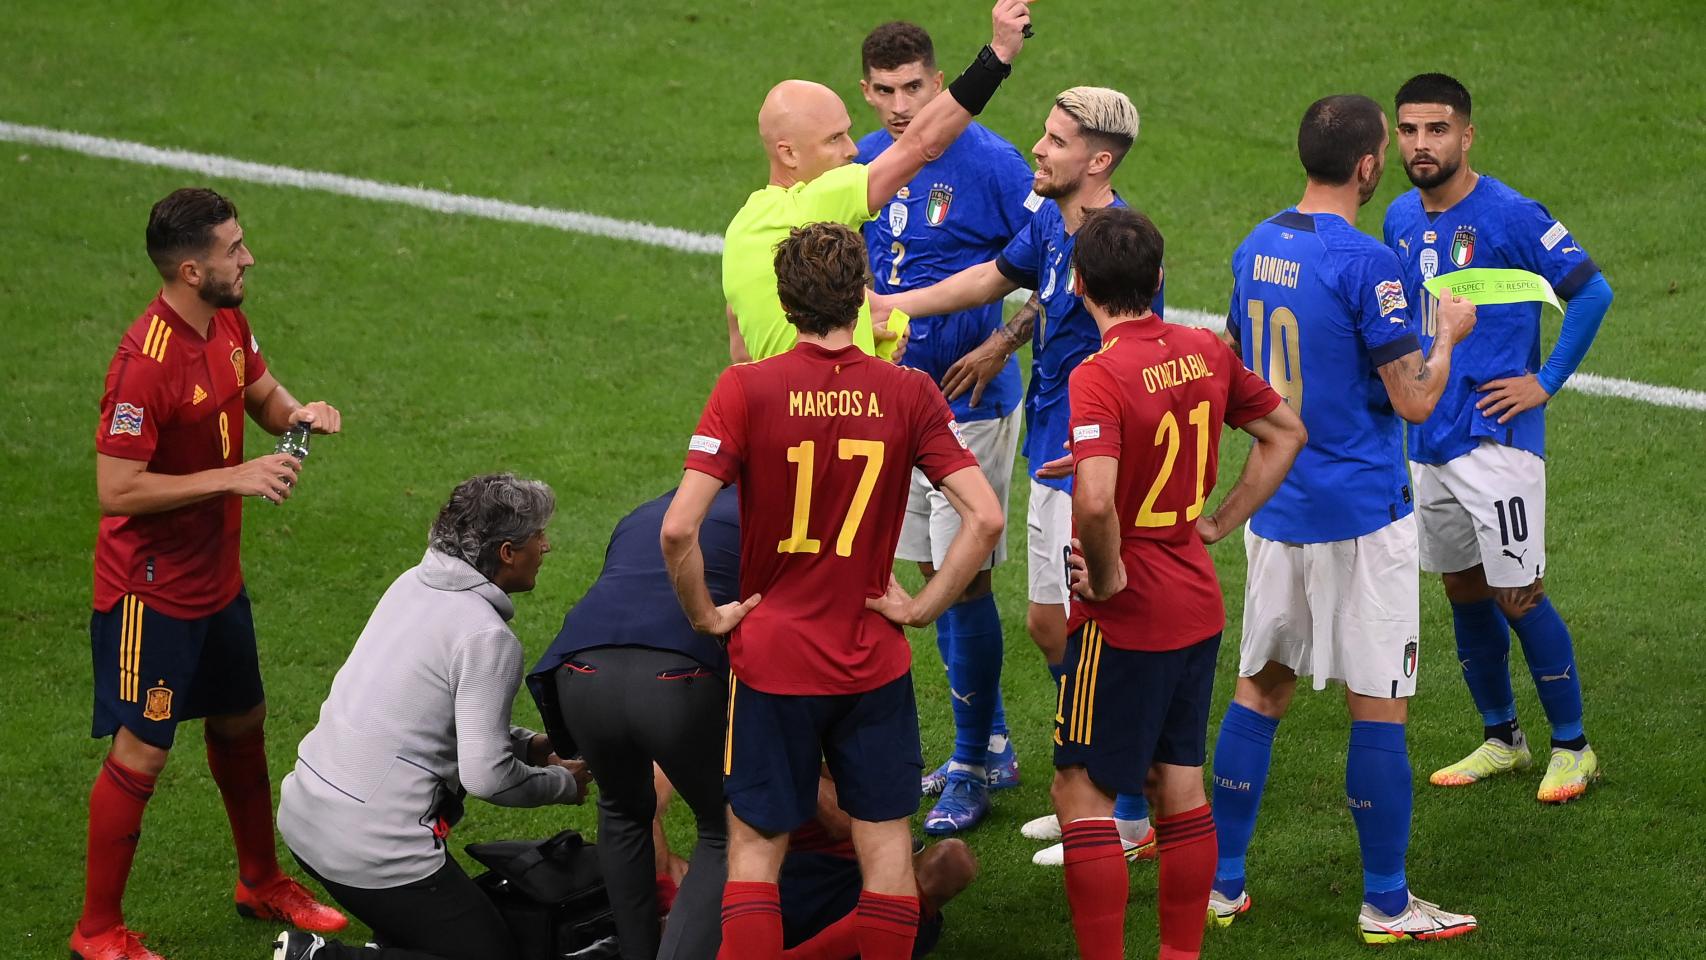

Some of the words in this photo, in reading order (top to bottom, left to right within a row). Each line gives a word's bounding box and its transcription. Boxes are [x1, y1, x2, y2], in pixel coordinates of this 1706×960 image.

[888, 241, 905, 285] 2
[1252, 254, 1301, 290] BONUCCI
[1452, 282, 1486, 294] RESPECT
[1506, 282, 1540, 291] RESPECT
[789, 390, 863, 417] MARCOS
[867, 393, 884, 418] A.
[219, 411, 231, 460] 8
[1134, 400, 1211, 528] 21
[777, 438, 886, 557] 17
[1494, 496, 1529, 546] 10
